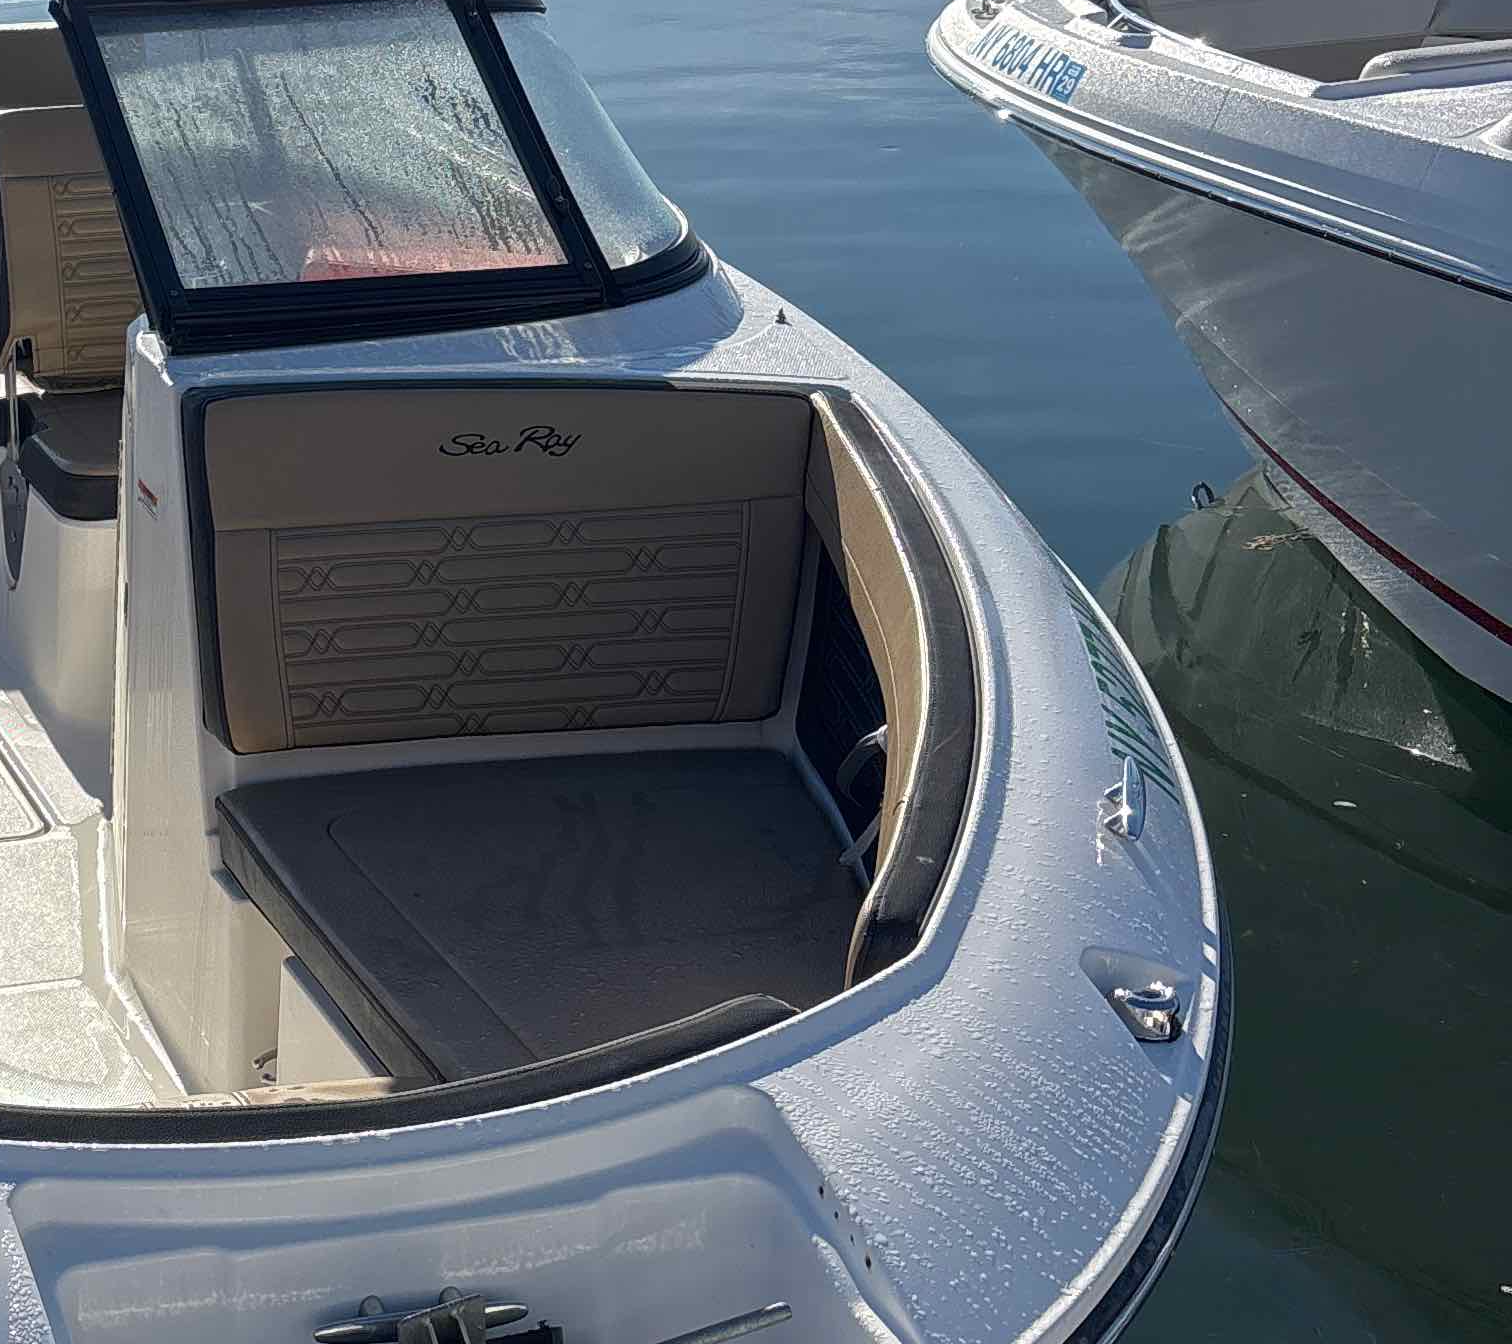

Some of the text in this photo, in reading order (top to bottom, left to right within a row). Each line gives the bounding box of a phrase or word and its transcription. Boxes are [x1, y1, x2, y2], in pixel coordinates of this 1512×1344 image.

[971, 22, 1070, 96] NY 6804 HR
[1055, 75, 1077, 95] 29
[438, 425, 582, 457] Sea Ray
